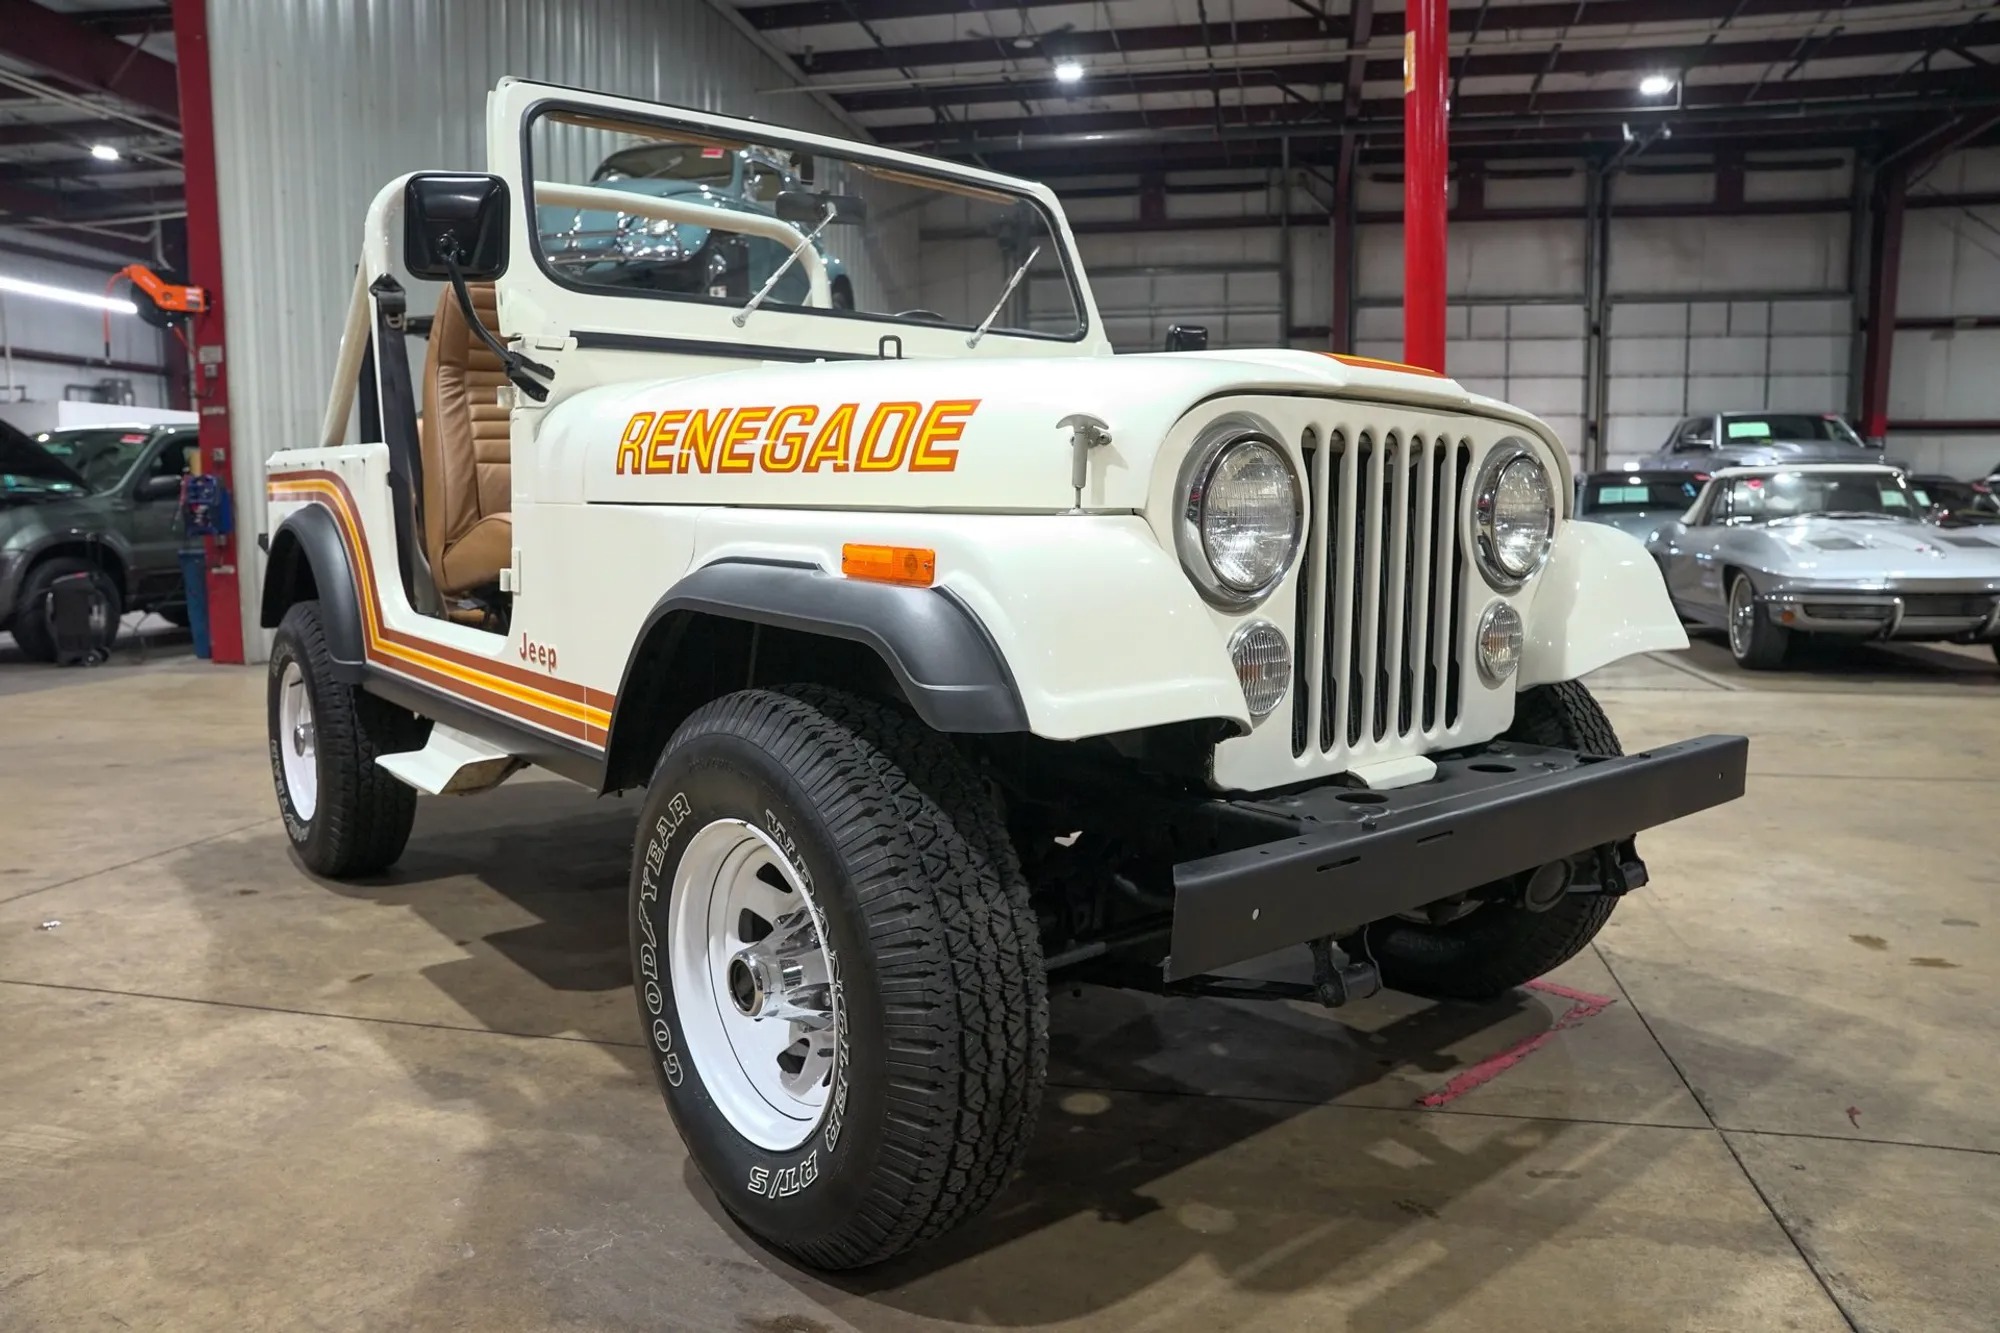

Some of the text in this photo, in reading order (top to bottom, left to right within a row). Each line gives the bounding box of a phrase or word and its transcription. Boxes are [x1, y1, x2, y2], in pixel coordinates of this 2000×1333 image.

[616, 398, 983, 475] RENEGADE
[519, 632, 557, 673] Jeep
[747, 1150, 819, 1199] RT/S
